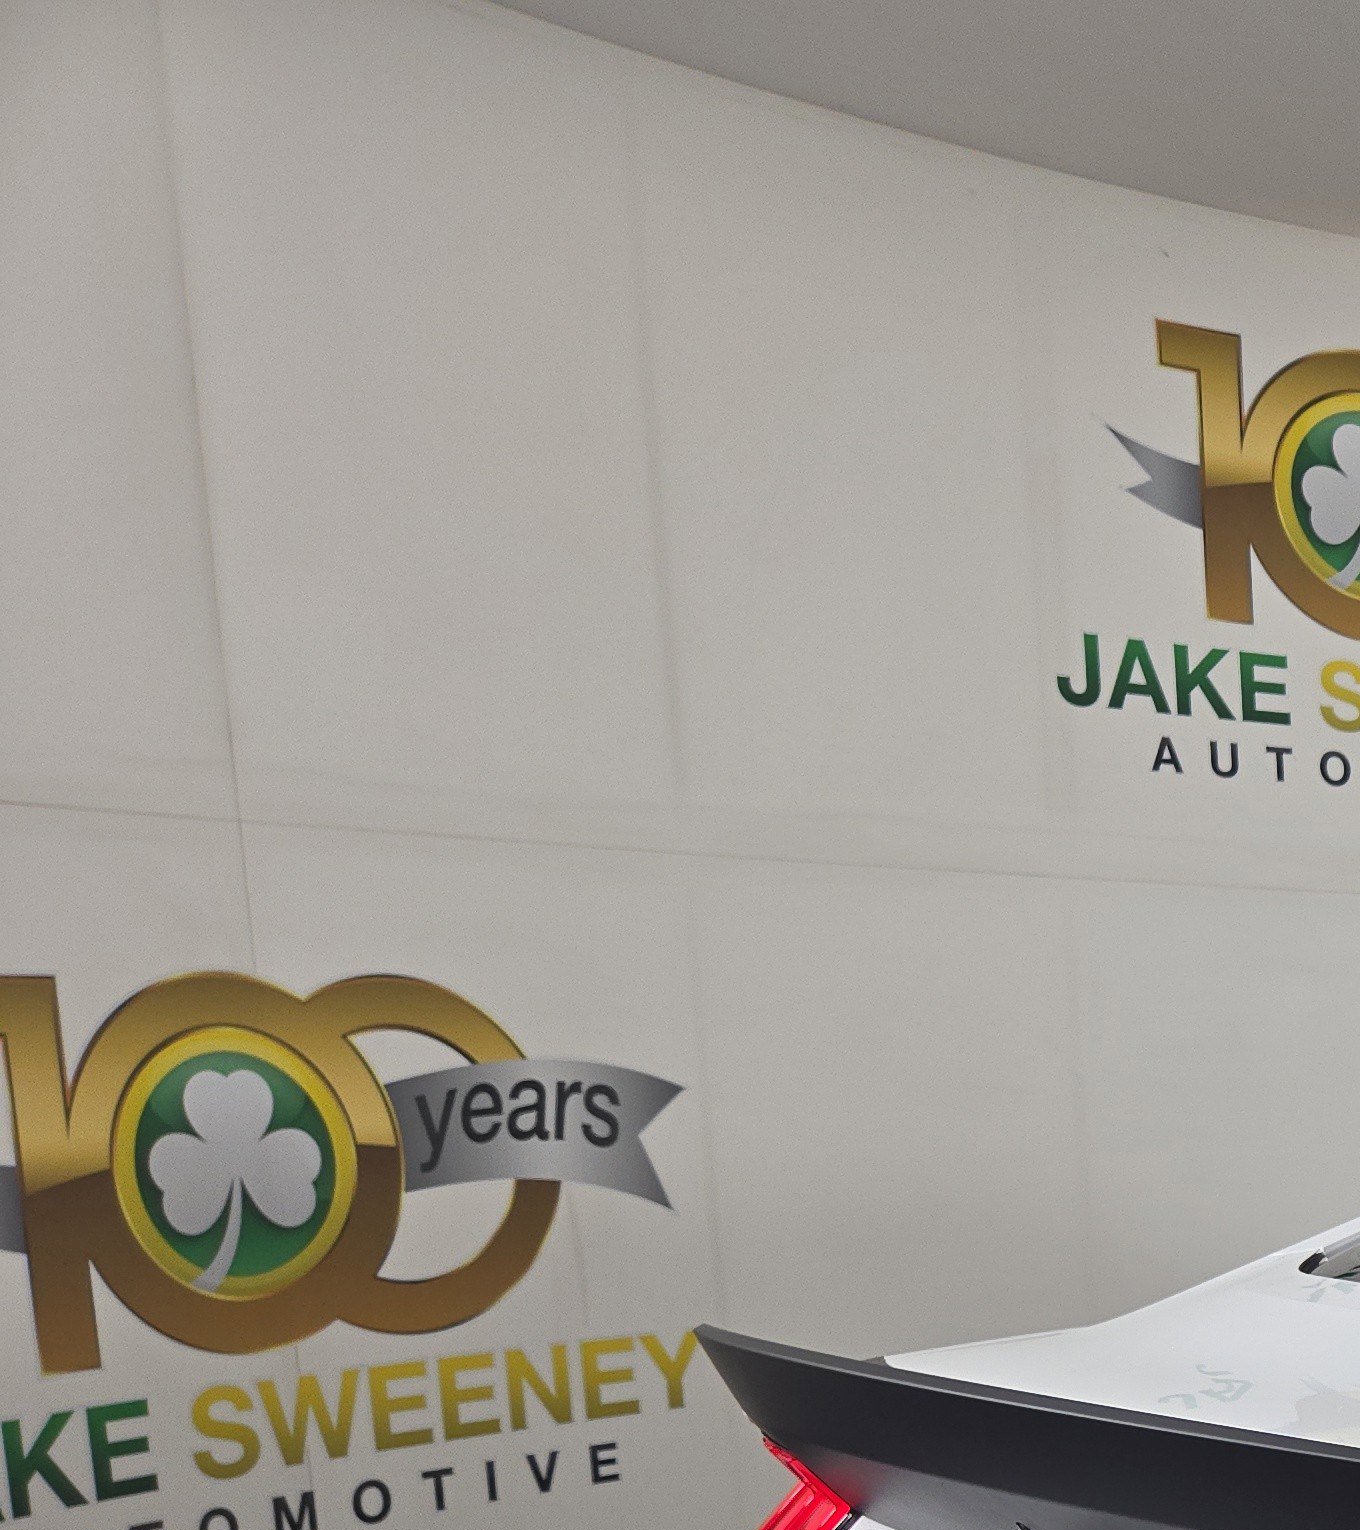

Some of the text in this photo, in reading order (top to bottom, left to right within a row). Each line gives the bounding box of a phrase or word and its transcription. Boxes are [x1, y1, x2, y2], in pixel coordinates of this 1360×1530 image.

[1056, 632, 1292, 727] JAKE
[414, 1078, 621, 1173] years
[0, 1329, 698, 1524] KE SWEENEY
